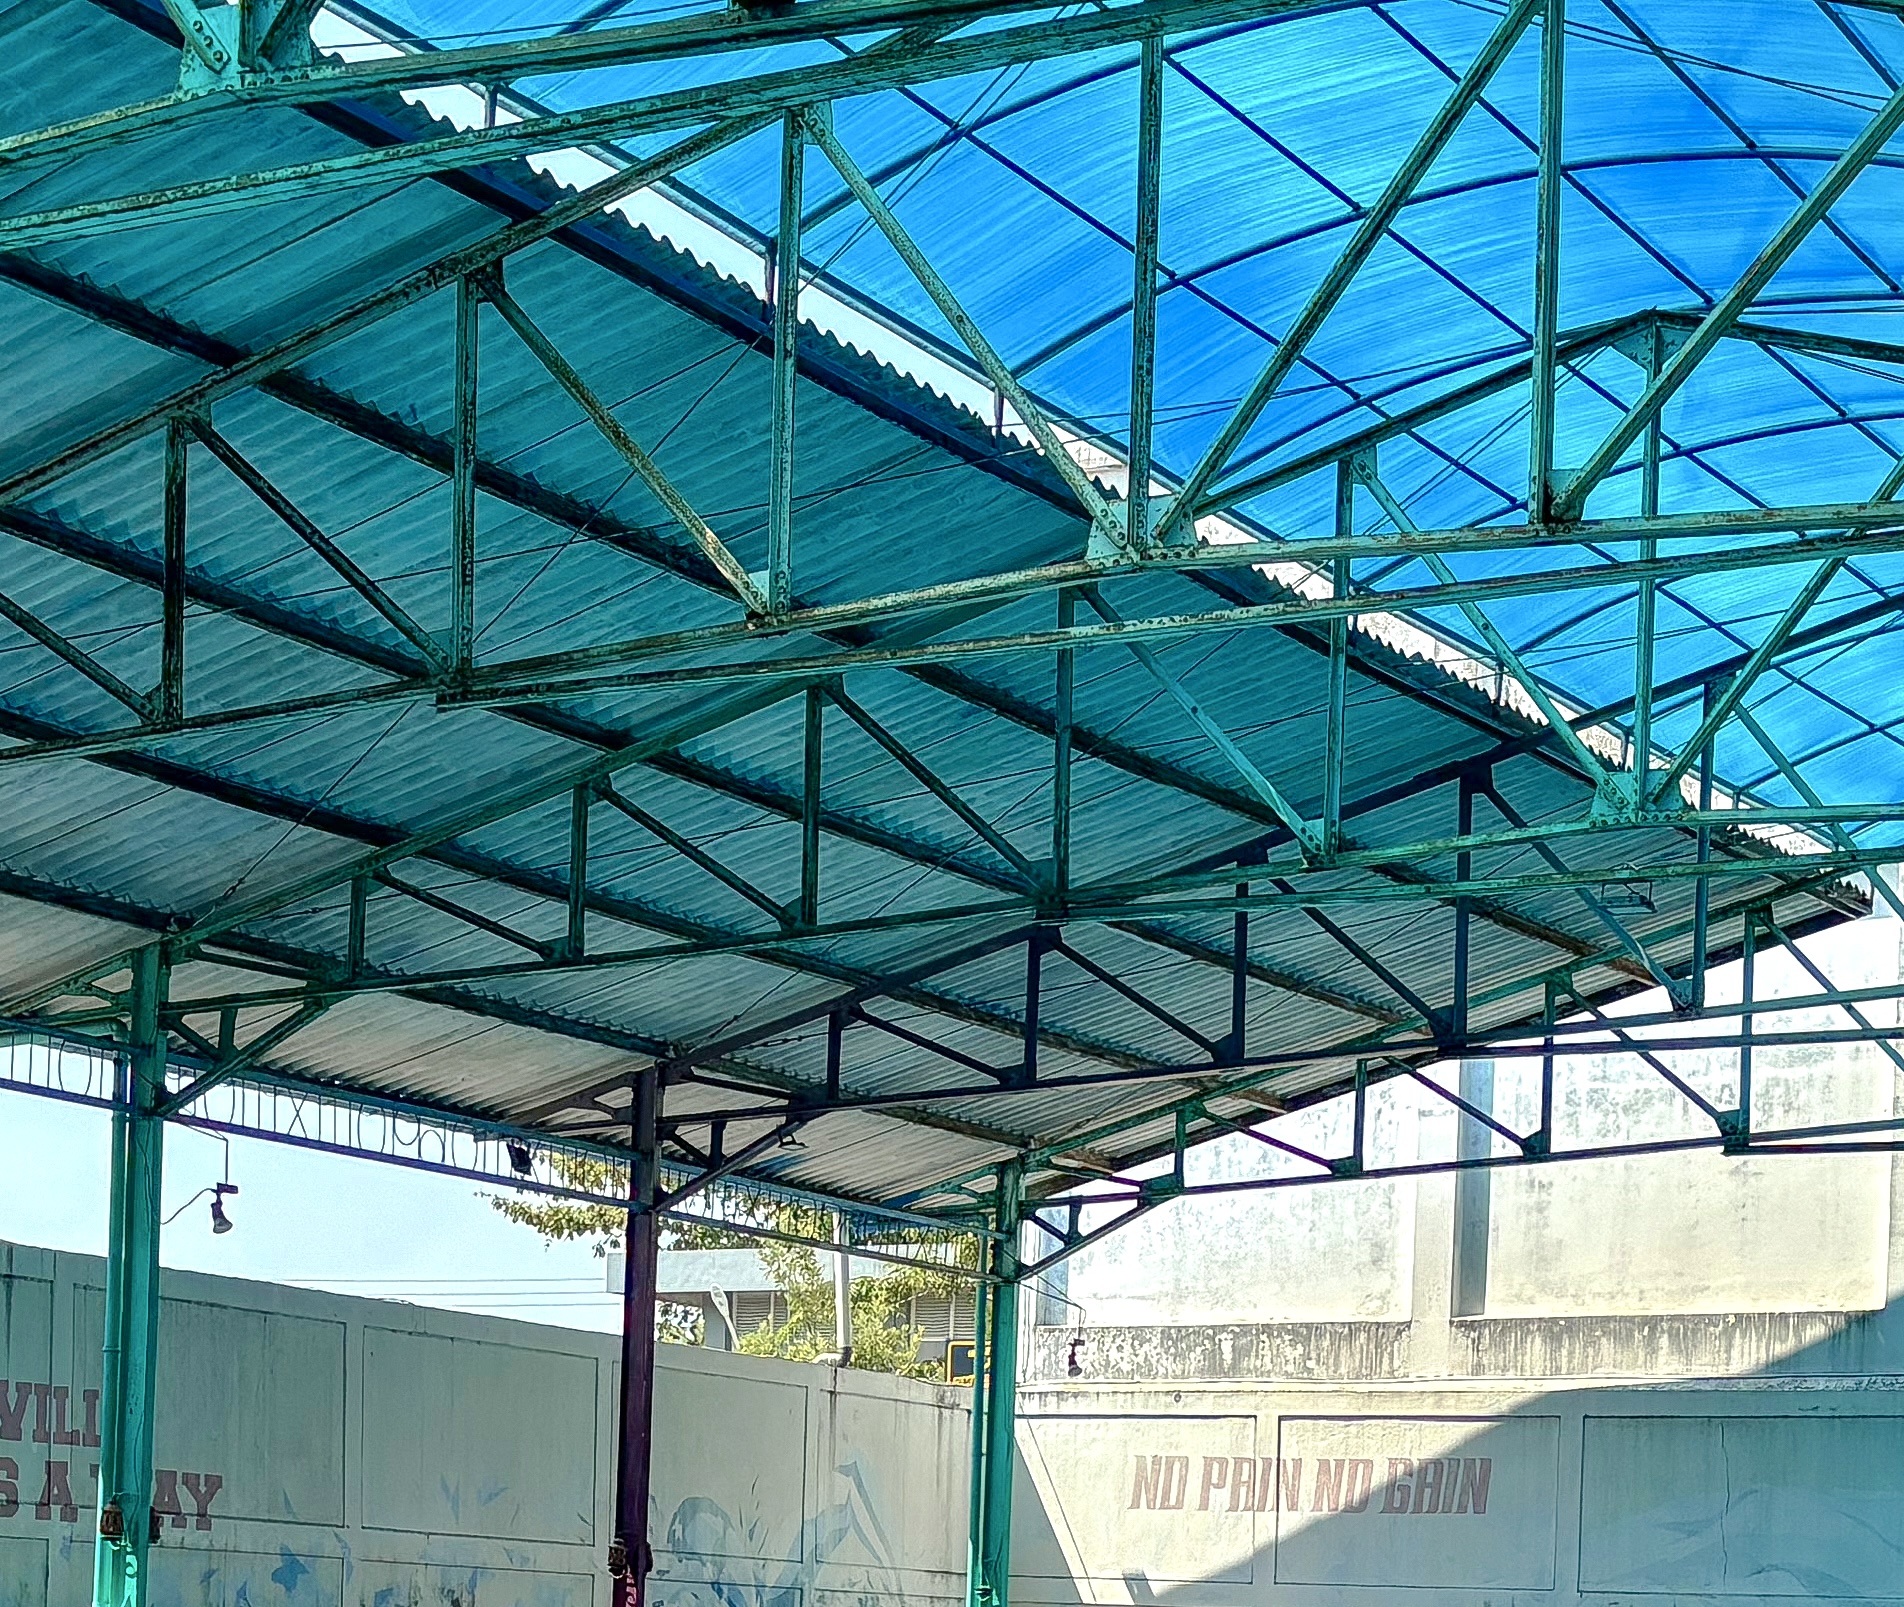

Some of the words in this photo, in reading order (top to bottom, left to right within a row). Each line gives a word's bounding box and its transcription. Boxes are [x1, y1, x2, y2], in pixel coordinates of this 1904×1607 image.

[35, 1460, 79, 1523] A
[89, 1463, 223, 1531] AY
[1128, 1455, 1190, 1510] NO
[1197, 1456, 1303, 1513] PAIN
[1310, 1458, 1374, 1514] NO
[1379, 1457, 1493, 1515] GAIN
